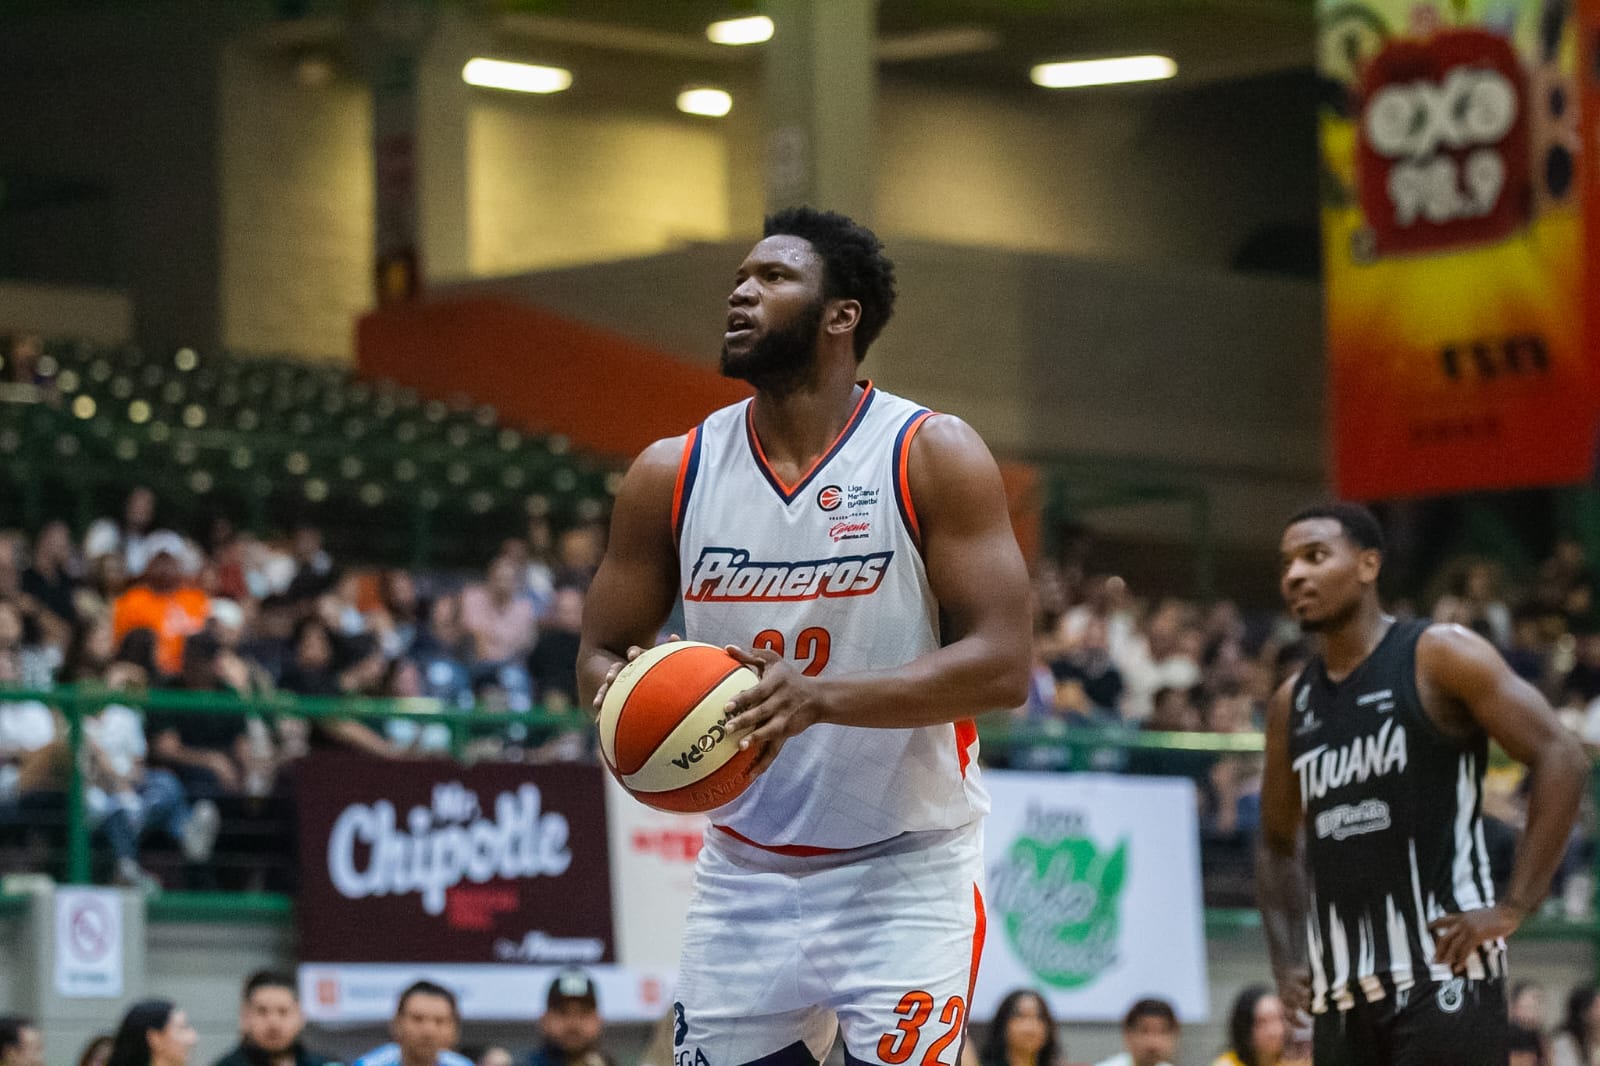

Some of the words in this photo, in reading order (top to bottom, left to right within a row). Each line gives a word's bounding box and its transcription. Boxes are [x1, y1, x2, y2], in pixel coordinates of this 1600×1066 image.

[848, 485, 862, 493] Liga
[684, 546, 895, 602] Pioneros
[327, 783, 573, 915] Chipotle
[877, 990, 965, 1066] 32
